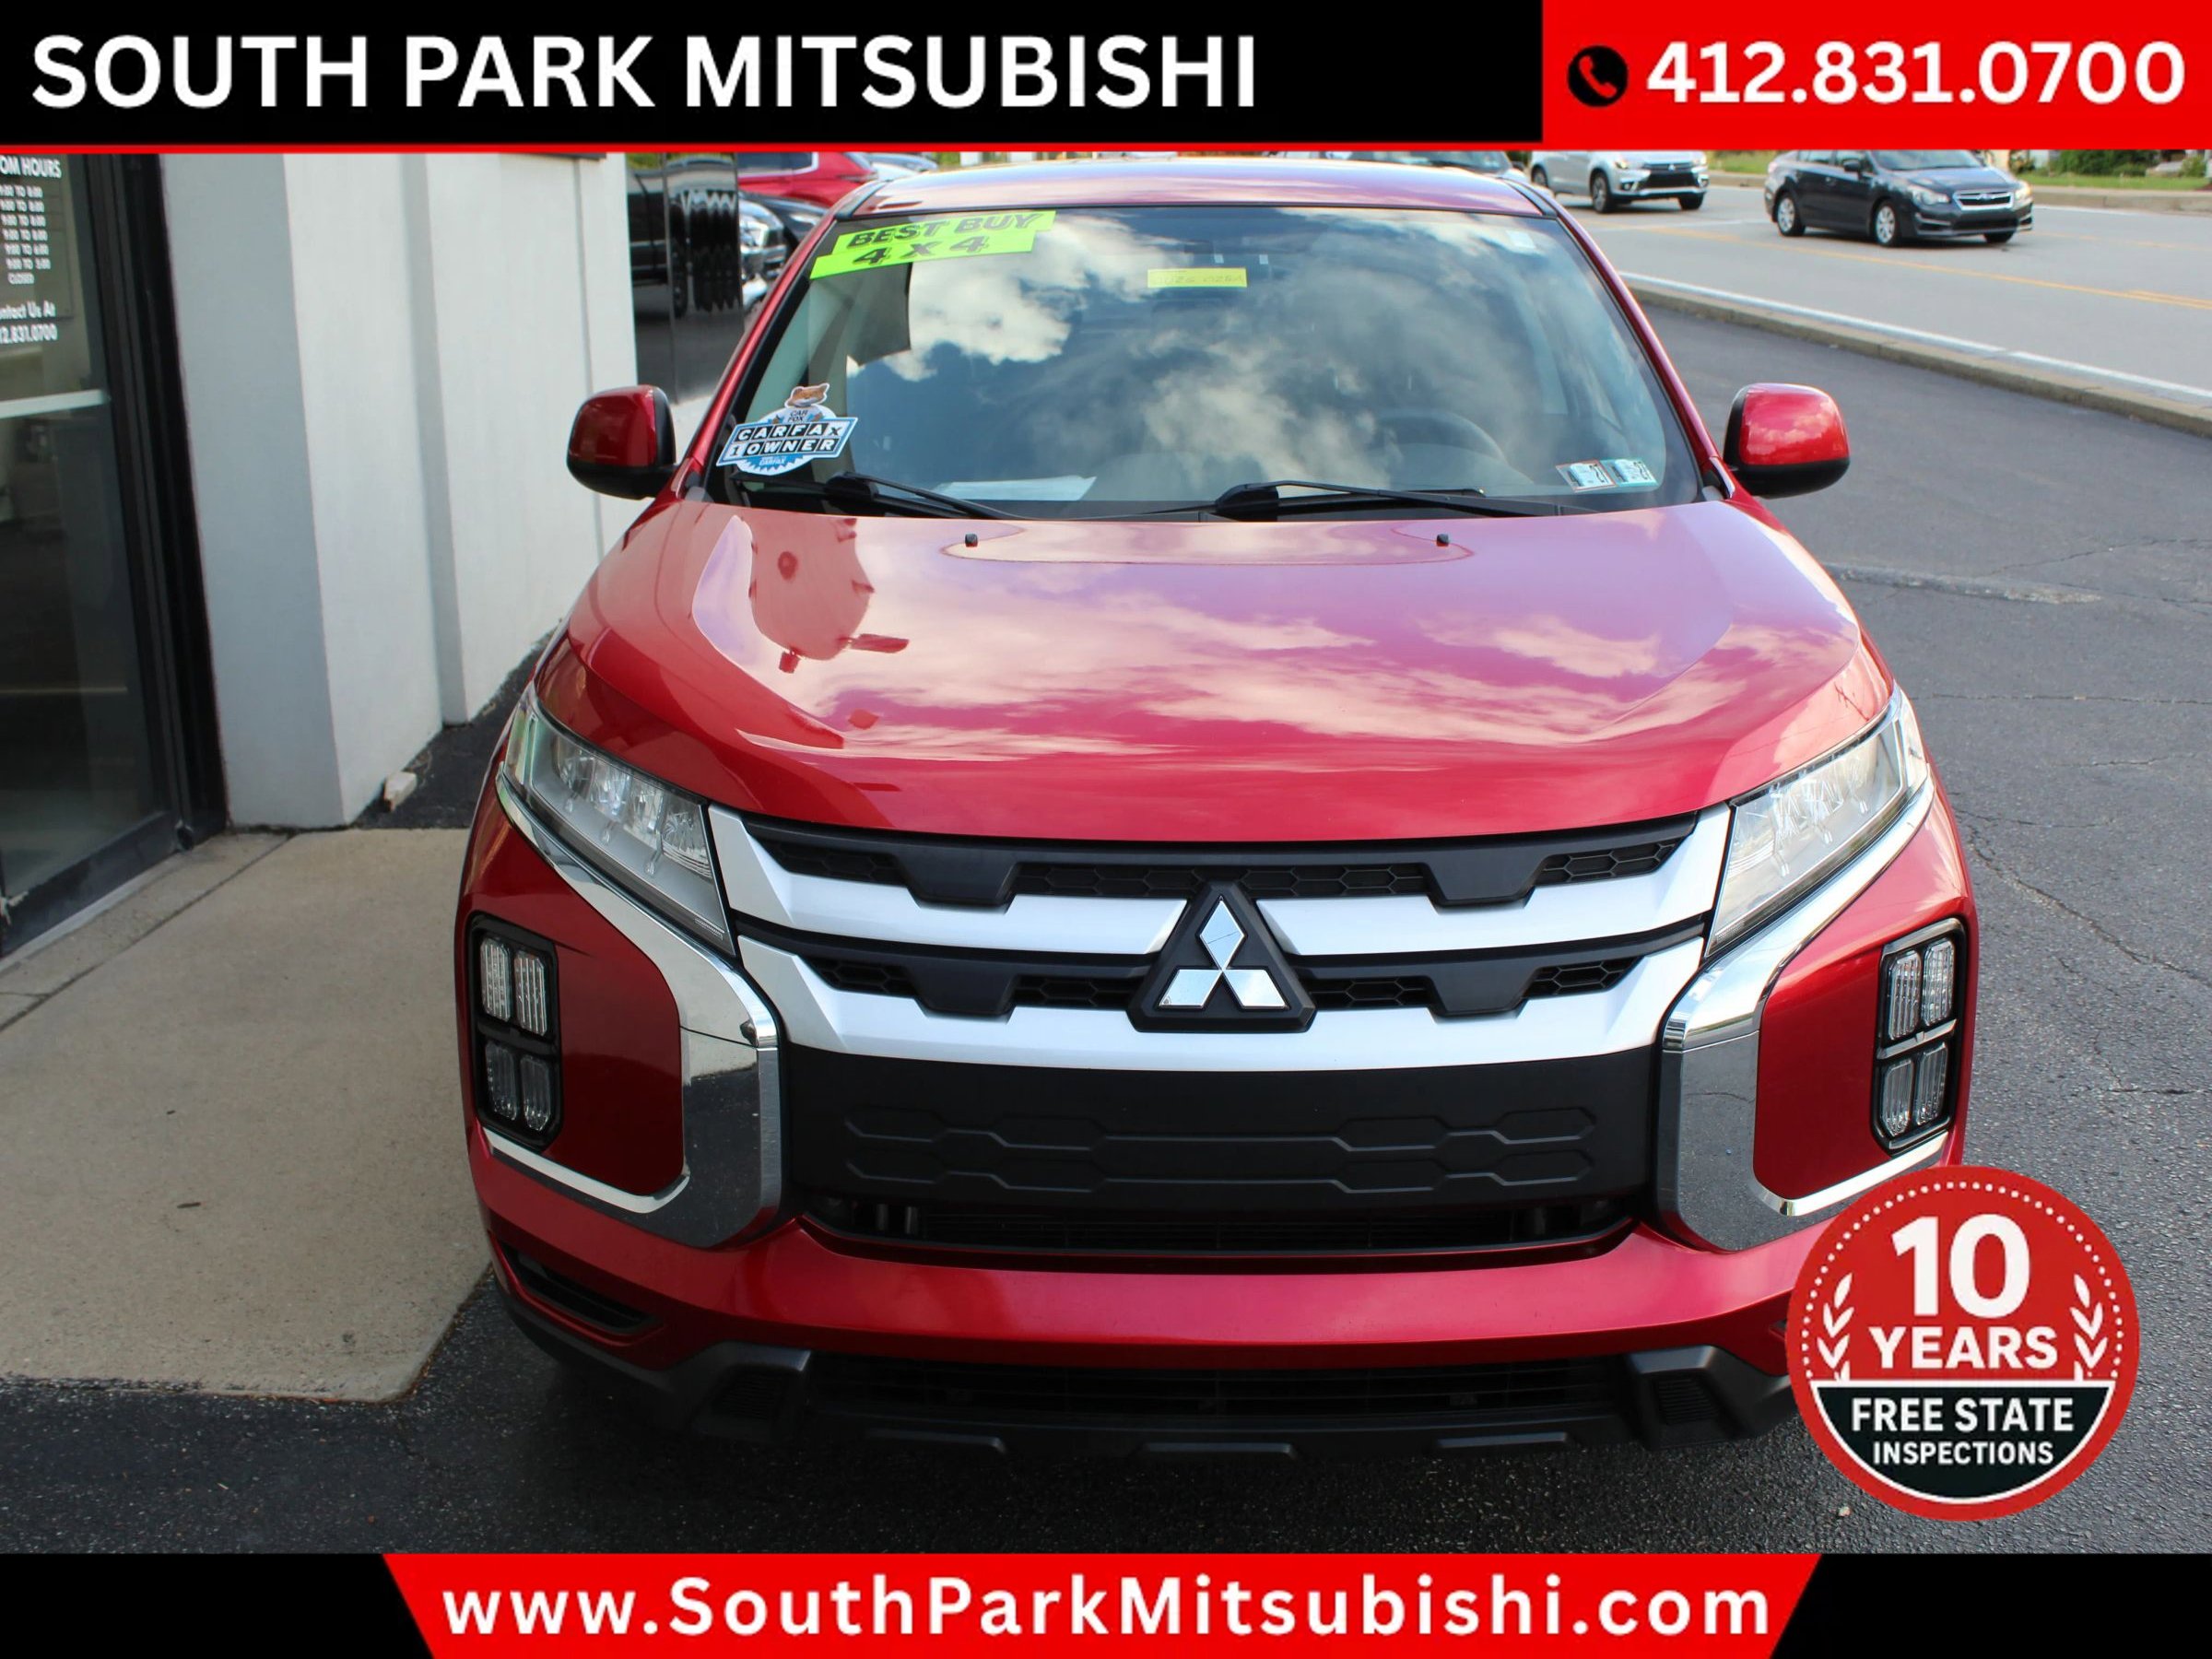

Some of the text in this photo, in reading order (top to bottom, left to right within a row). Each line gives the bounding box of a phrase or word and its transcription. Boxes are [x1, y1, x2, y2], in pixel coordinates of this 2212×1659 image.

[20, 157, 62, 178] HOURS
[846, 213, 1044, 249] BEST BUY
[853, 247, 892, 265] 4
[950, 235, 990, 253] 4
[737, 424, 842, 441] CARFAX
[747, 439, 836, 455] OWNER
